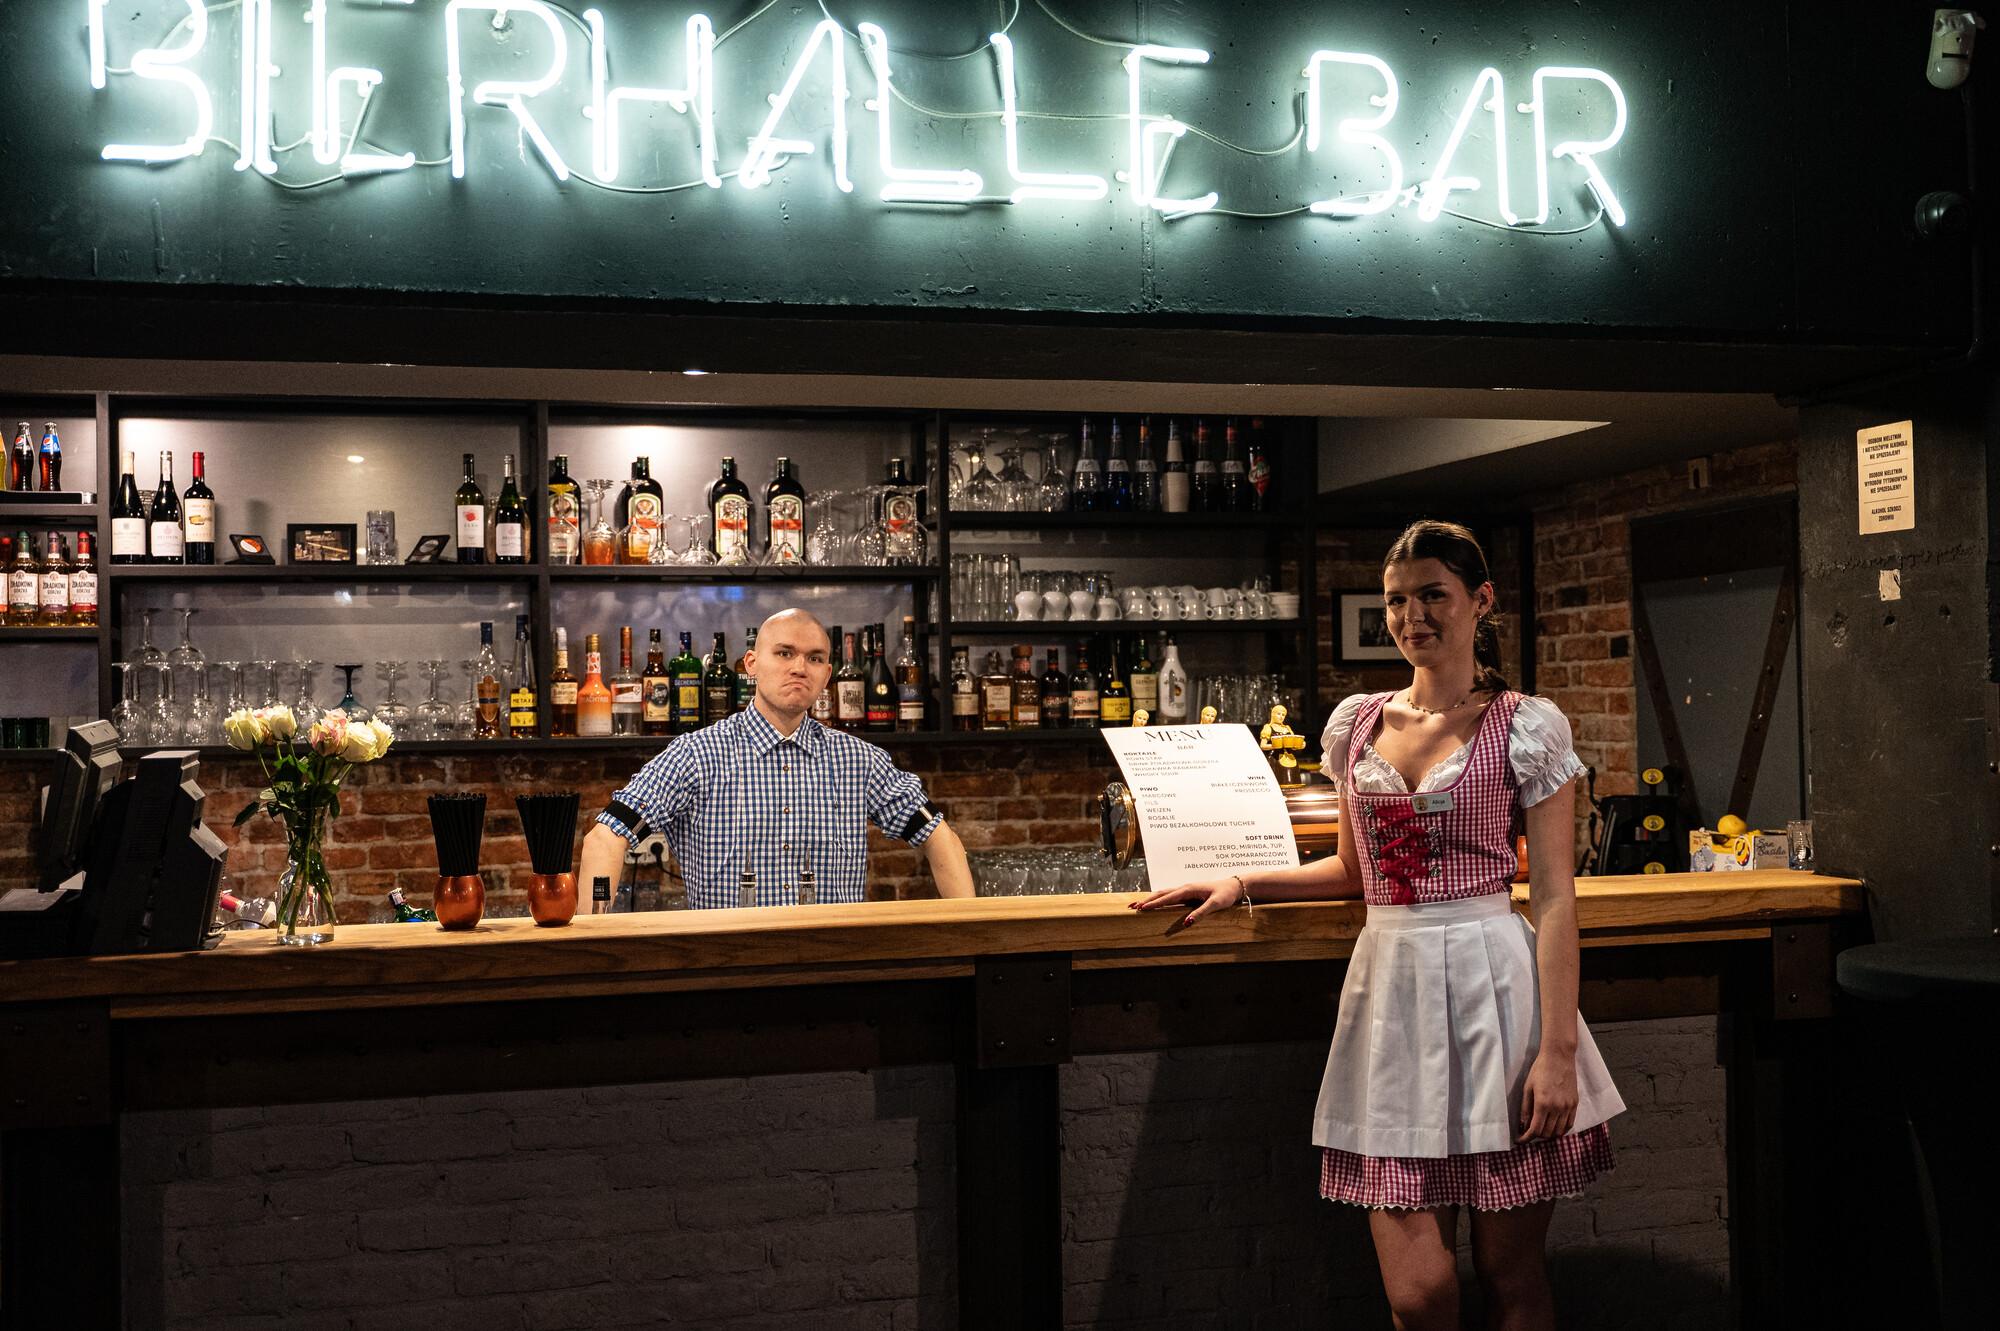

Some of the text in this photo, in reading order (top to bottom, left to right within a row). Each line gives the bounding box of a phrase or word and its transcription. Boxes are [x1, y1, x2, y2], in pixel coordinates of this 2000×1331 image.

[88, 0, 1631, 229] BIERHALLE BAR
[1144, 730, 1210, 742] MENU
[1251, 859, 1290, 867] PORZECZKA
